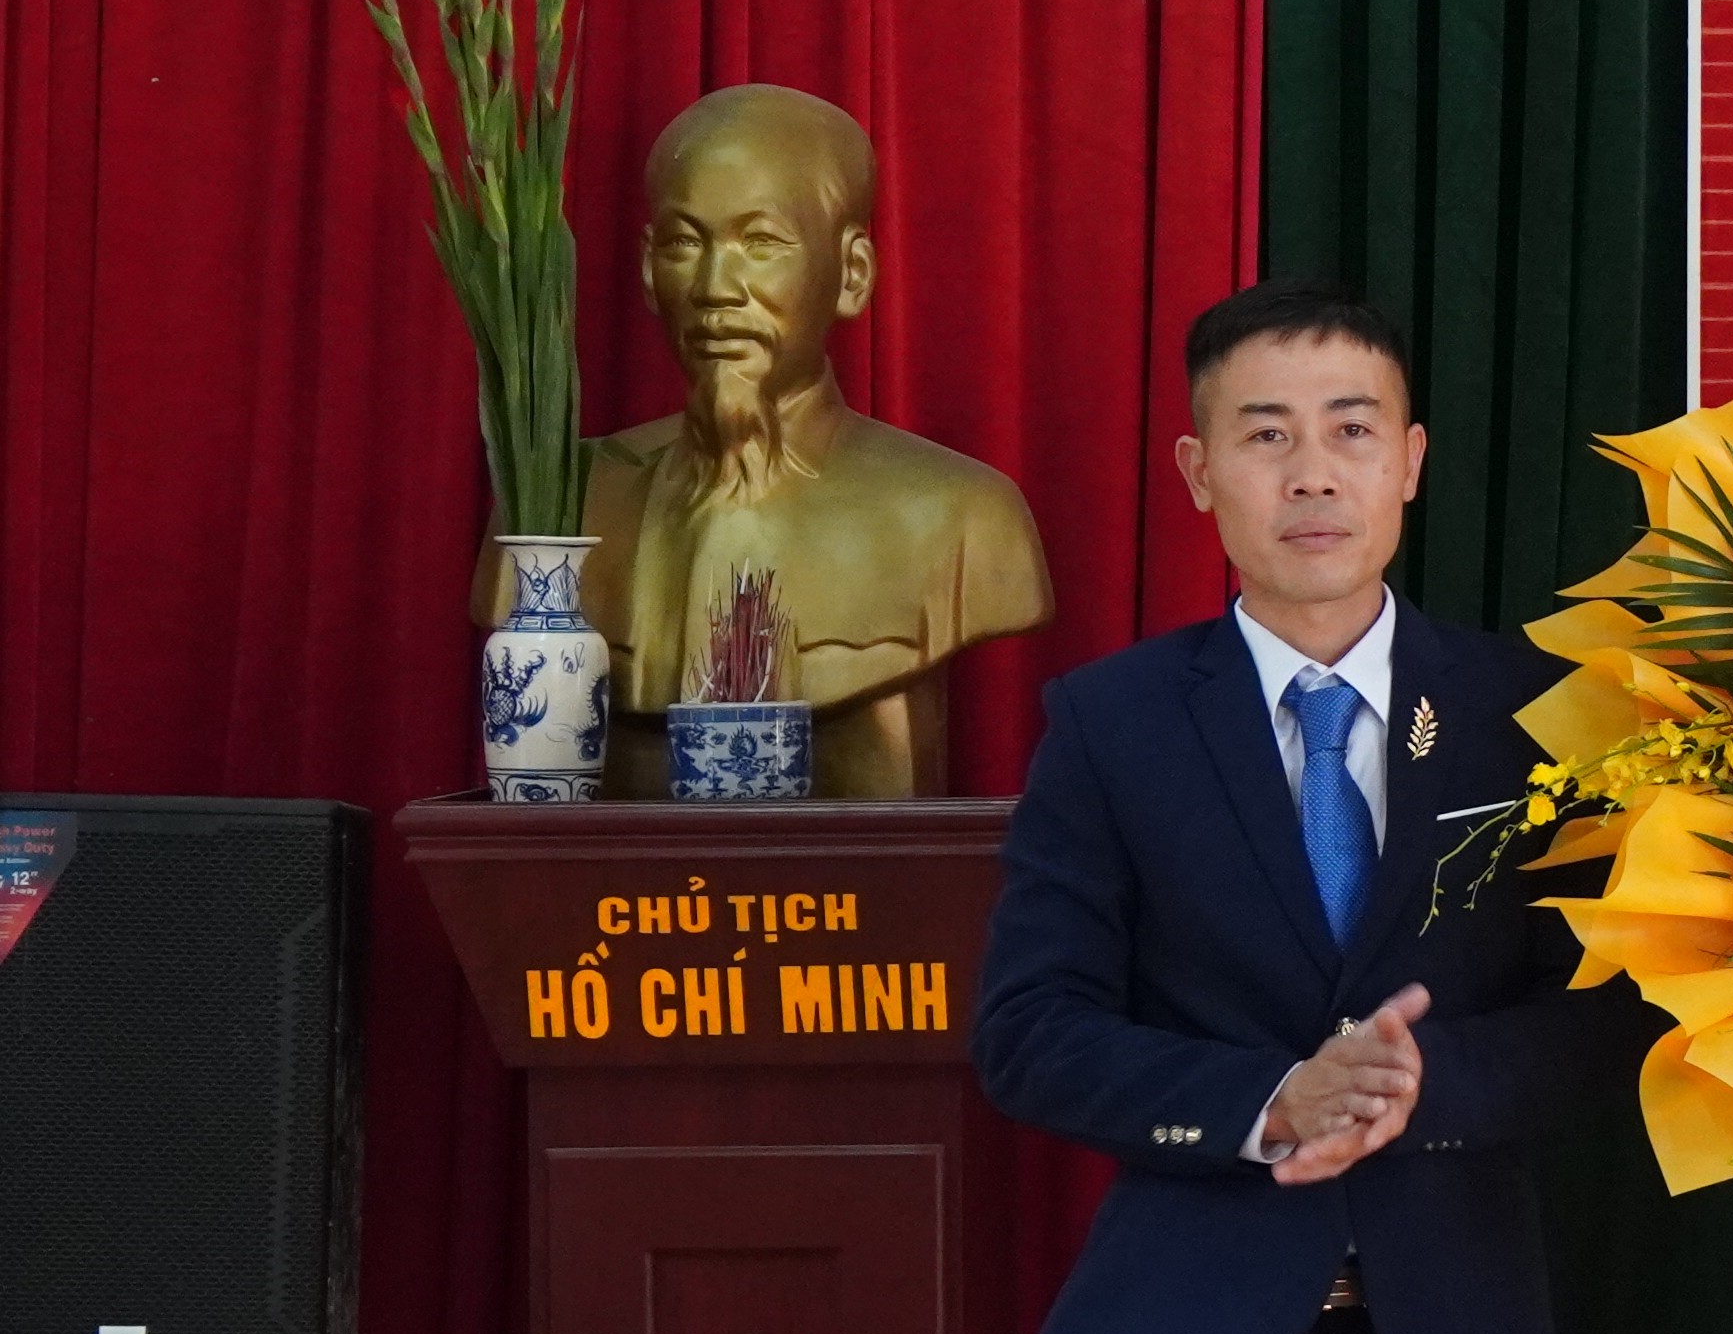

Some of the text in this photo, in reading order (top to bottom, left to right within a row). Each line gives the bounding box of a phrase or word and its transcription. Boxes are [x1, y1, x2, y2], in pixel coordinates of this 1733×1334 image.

[597, 876, 858, 943] CHỦ TỊCH
[526, 940, 949, 1040] HỒ CHÍ MINH
